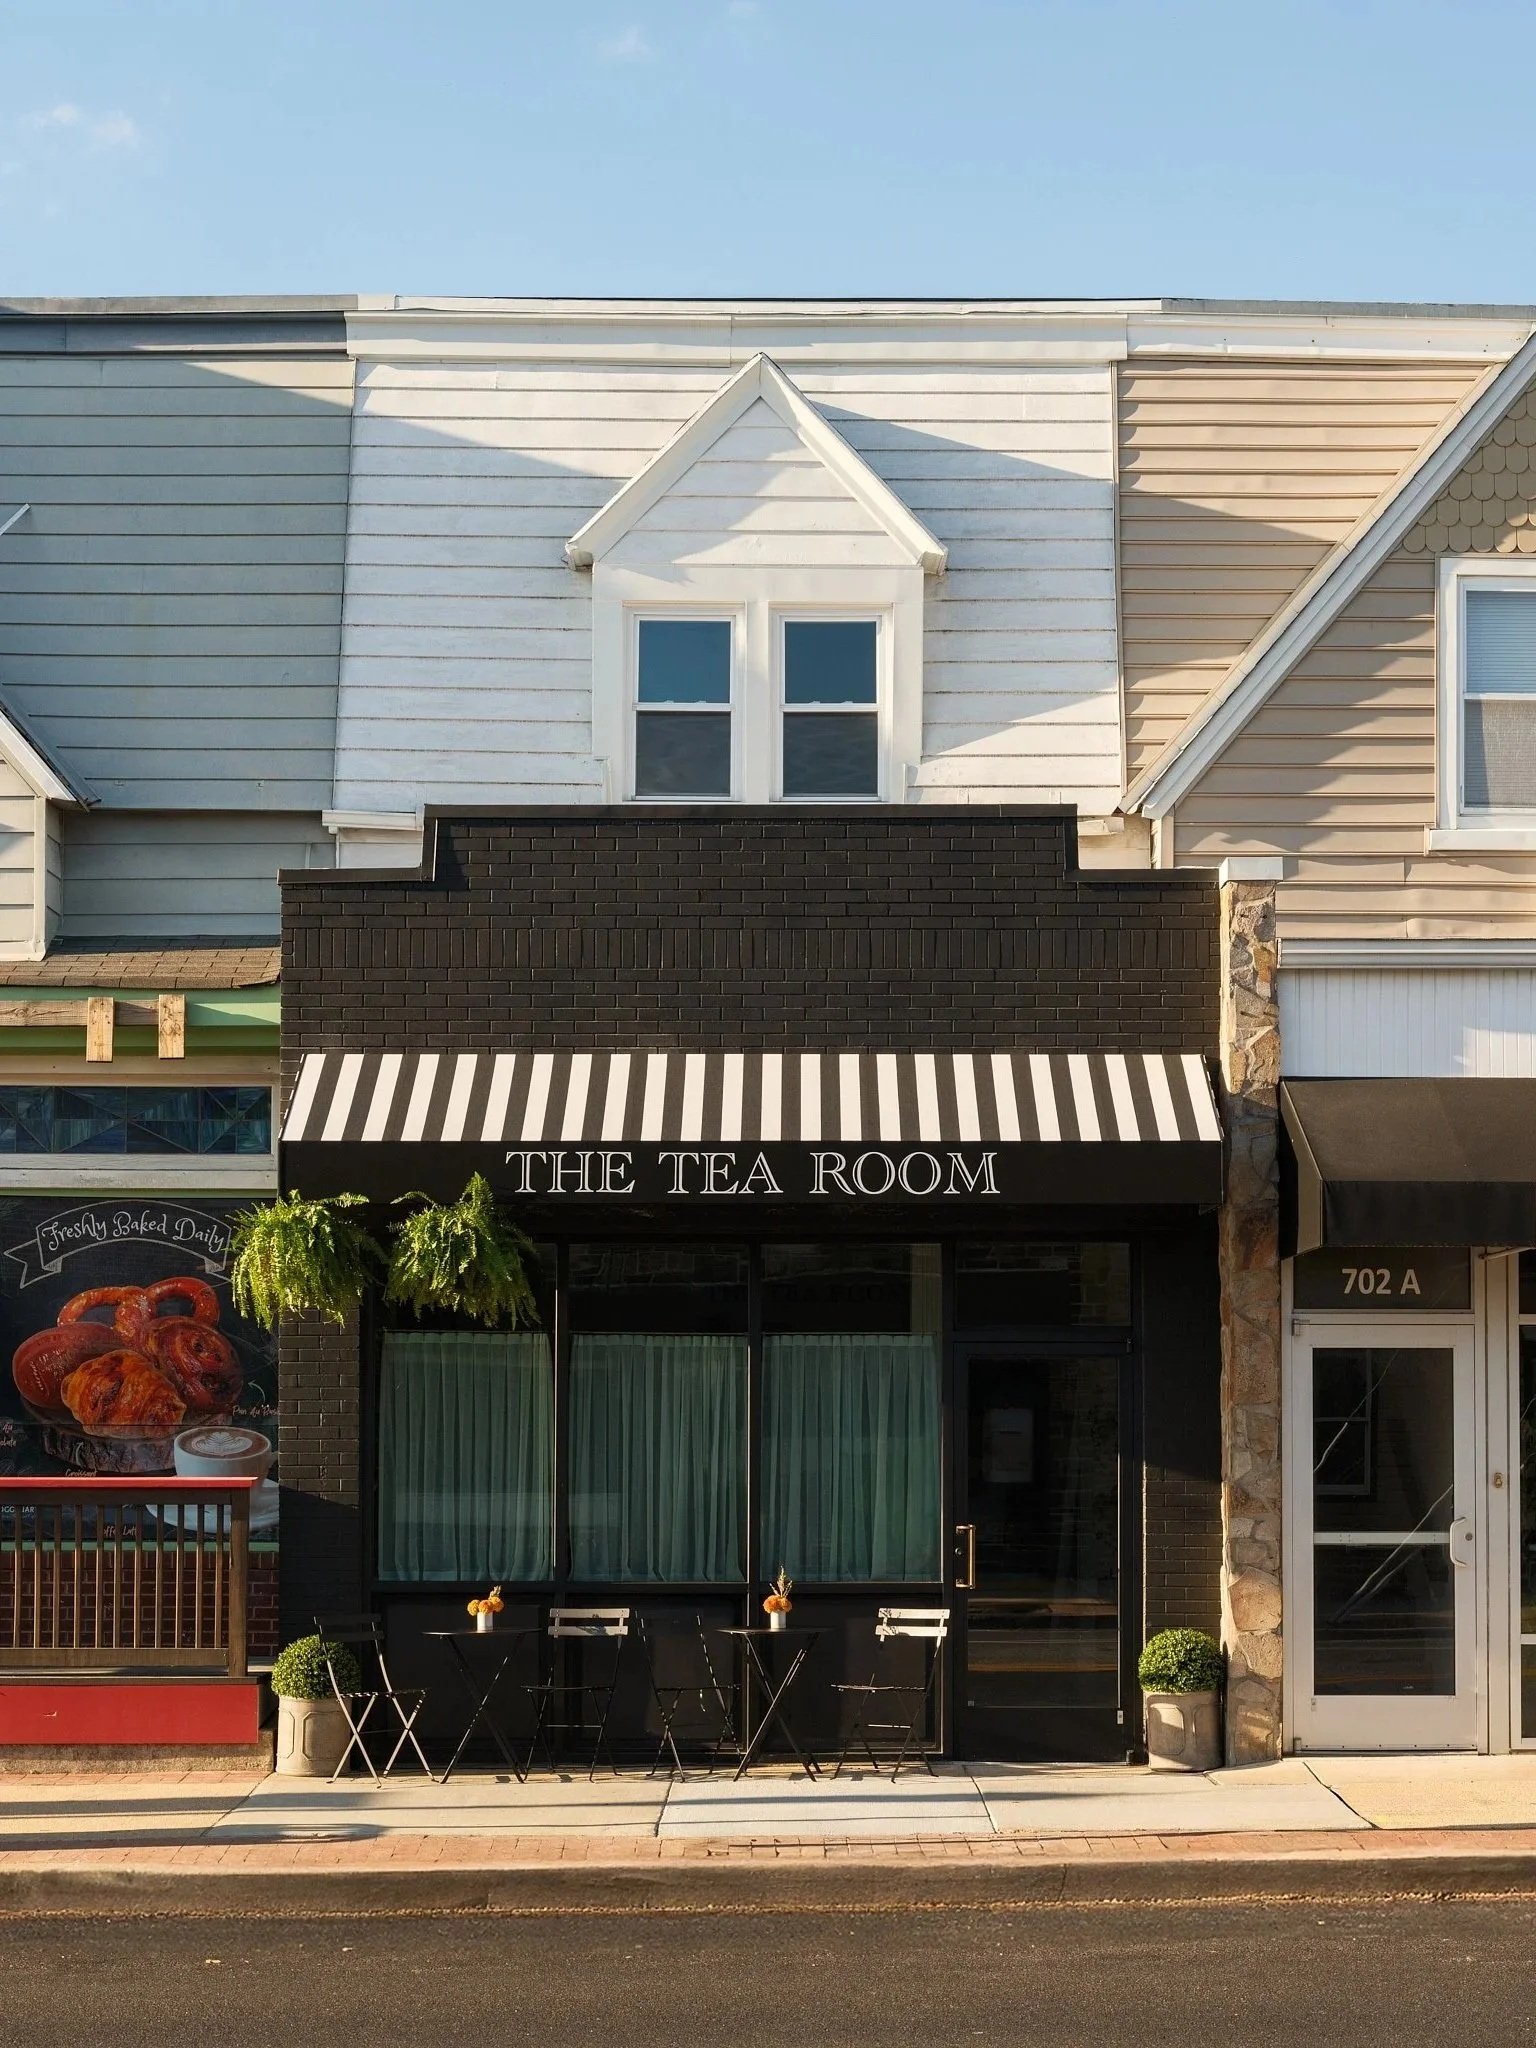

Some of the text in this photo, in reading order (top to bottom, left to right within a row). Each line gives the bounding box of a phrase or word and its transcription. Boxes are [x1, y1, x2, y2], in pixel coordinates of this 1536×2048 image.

[506, 1151, 1001, 1195] THE TEA ROOM
[41, 1210, 225, 1253] Freshly Baked Daily
[1341, 1268, 1421, 1295] 702 A
